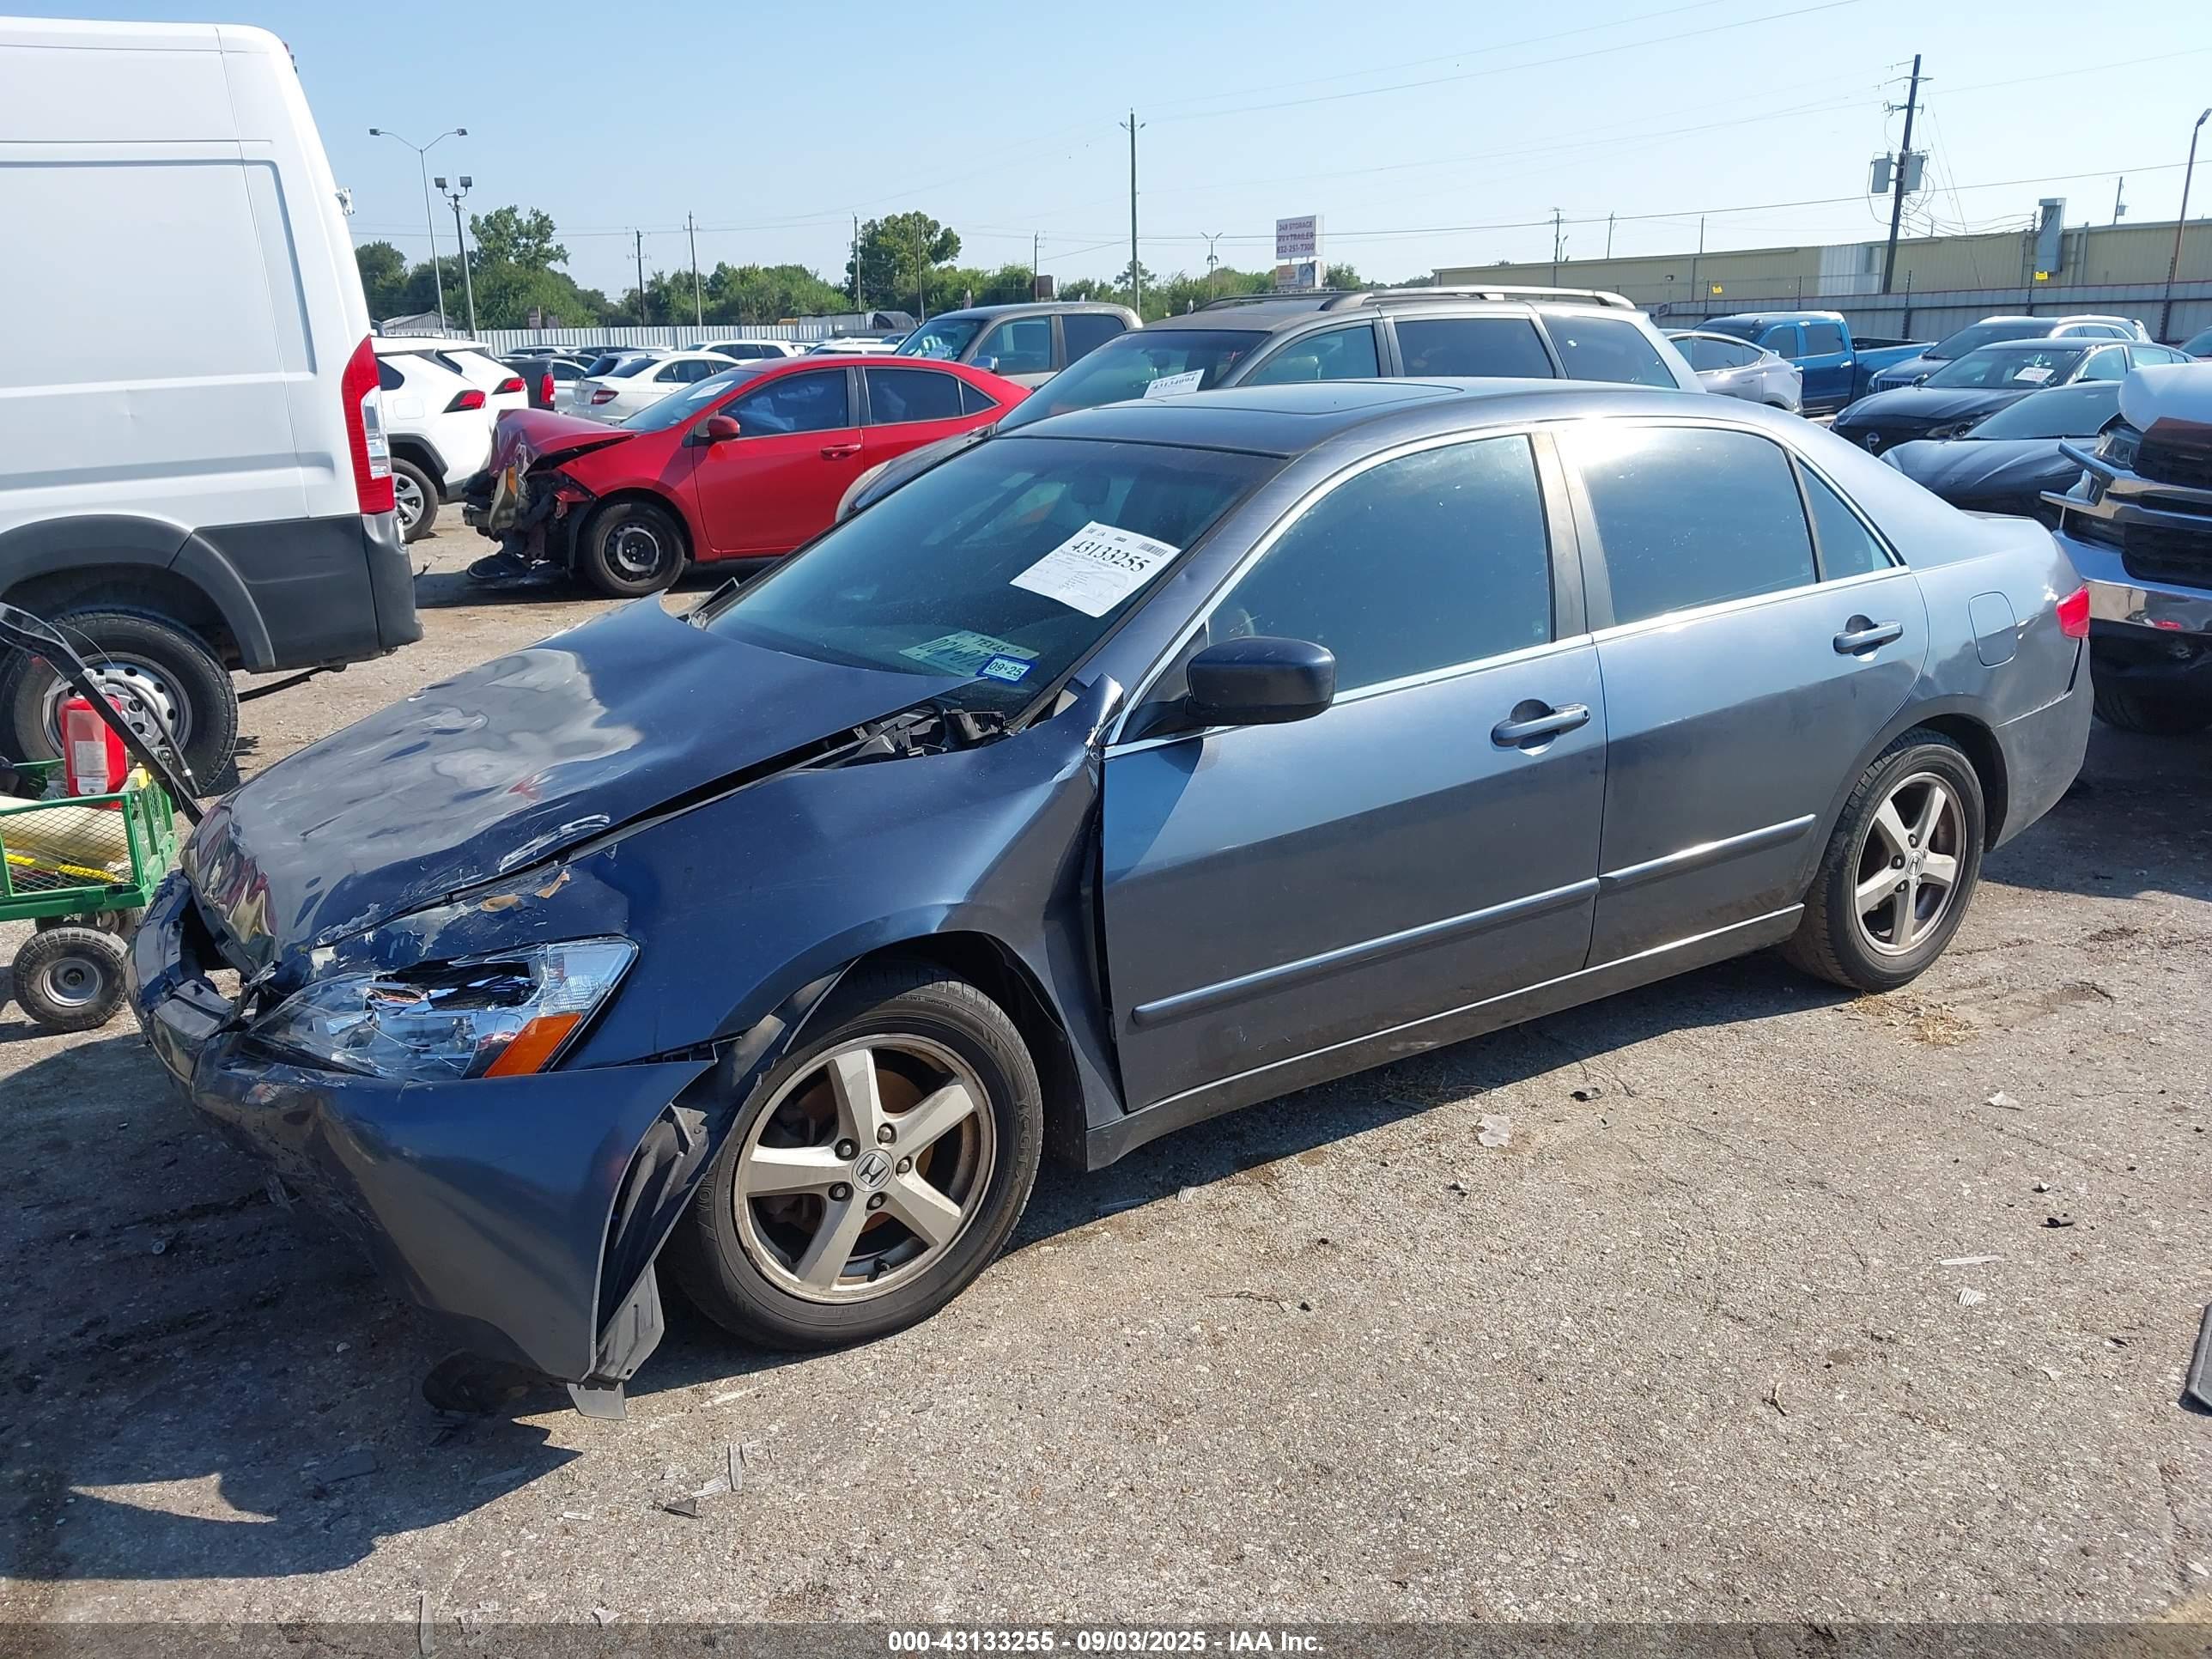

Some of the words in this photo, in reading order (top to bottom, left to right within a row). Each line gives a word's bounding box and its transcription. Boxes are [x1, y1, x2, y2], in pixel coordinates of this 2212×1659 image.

[1071, 540, 1152, 573] 43133255
[975, 638, 1010, 653] TEXAS
[988, 662, 1006, 672] 09
[1006, 666, 1024, 676] 25
